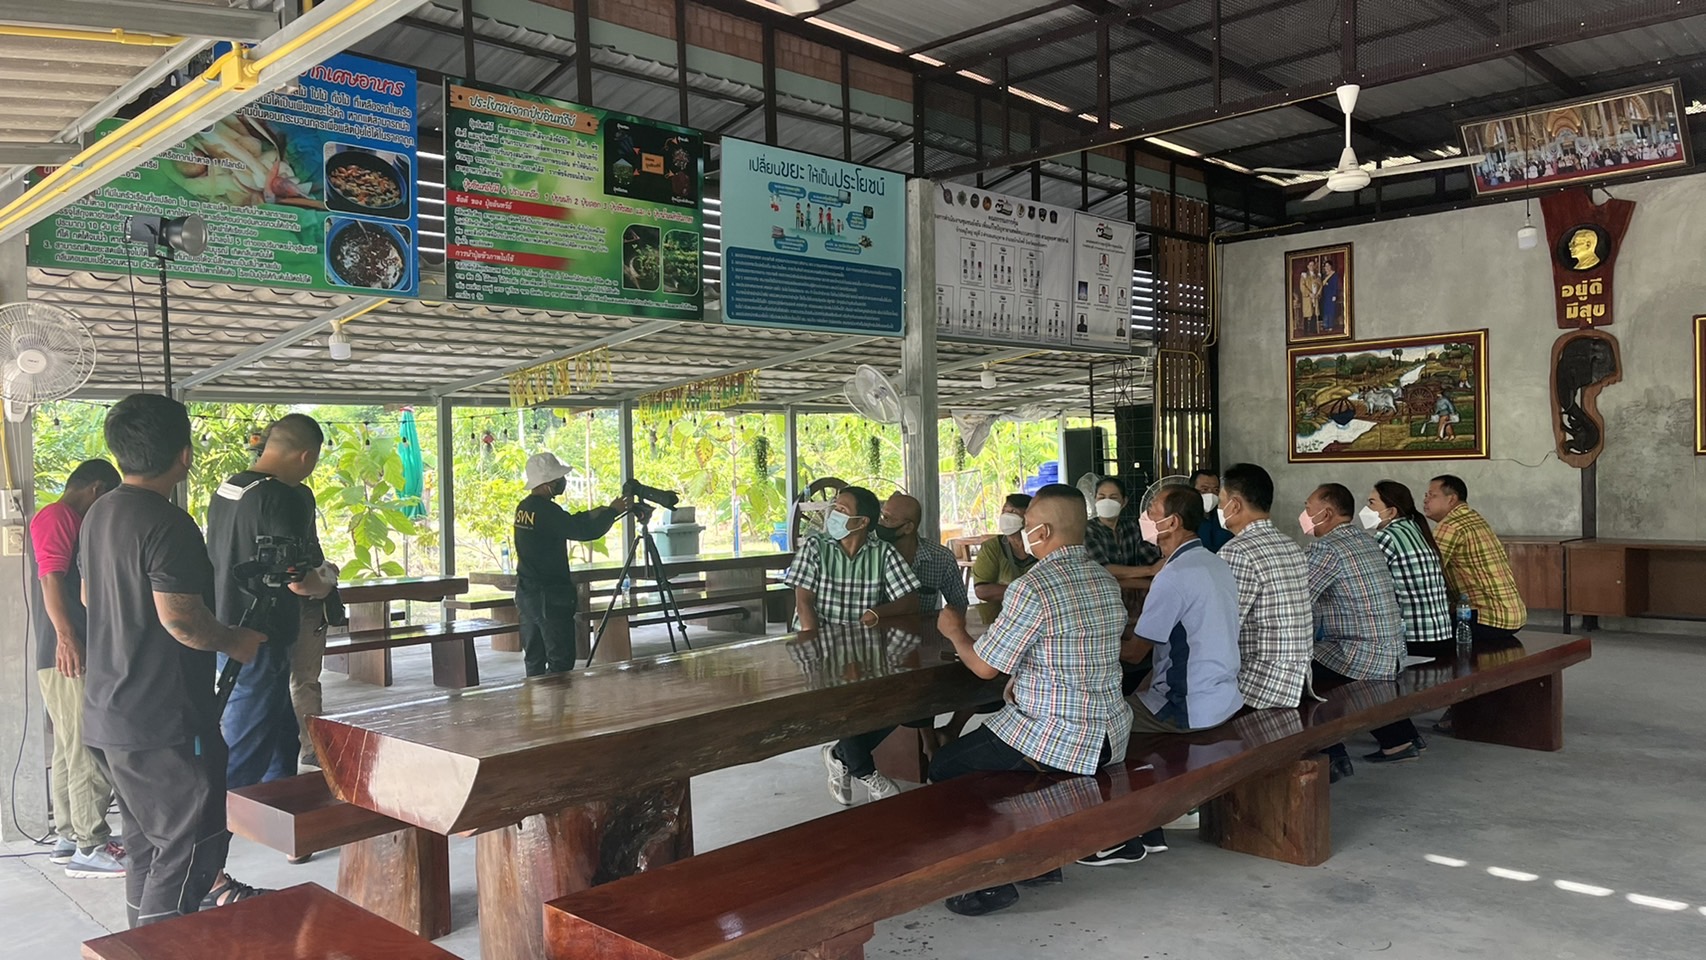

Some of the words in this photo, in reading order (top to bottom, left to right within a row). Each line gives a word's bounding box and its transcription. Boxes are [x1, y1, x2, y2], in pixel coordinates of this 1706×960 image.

[299, 65, 405, 97] ากเศษอาหาร
[468, 94, 577, 129] ประโยชน์จากปุ๋ยอินทรีย์
[749, 153, 805, 180] เปลี่ยนขยะ
[808, 164, 885, 197] ให้เป็นประโยชน์
[1561, 277, 1603, 301] อยู่ดี
[1566, 302, 1606, 324] มีสุข
